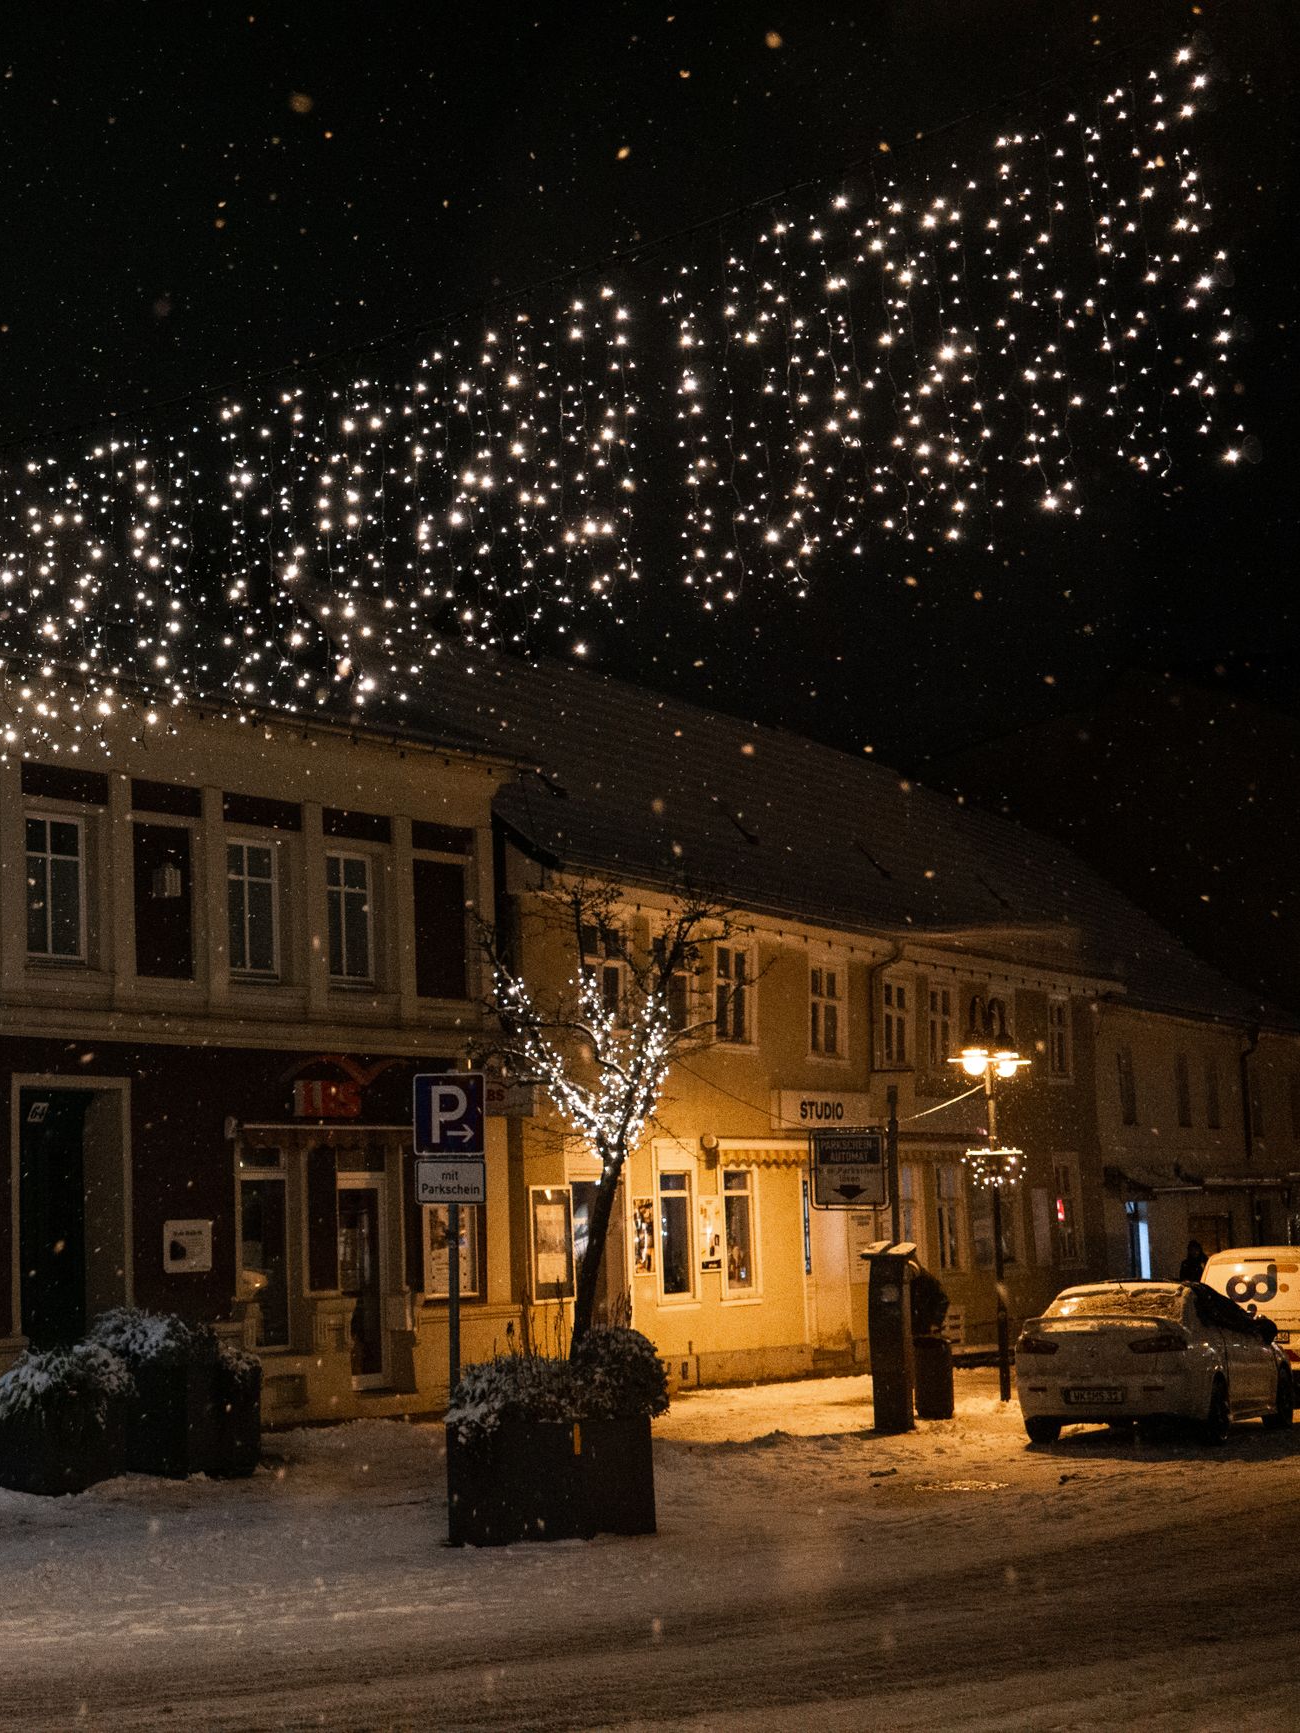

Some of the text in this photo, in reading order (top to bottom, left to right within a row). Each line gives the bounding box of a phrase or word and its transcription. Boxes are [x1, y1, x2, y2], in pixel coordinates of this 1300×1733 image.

[486, 1089, 505, 1101] BS
[30, 1105, 46, 1119] 64
[430, 1085, 468, 1143] P
[800, 1101, 844, 1119] STUDIO
[829, 1151, 868, 1161] AUTOMAT
[442, 1170, 459, 1181] mit
[421, 1184, 480, 1195] Parkschein
